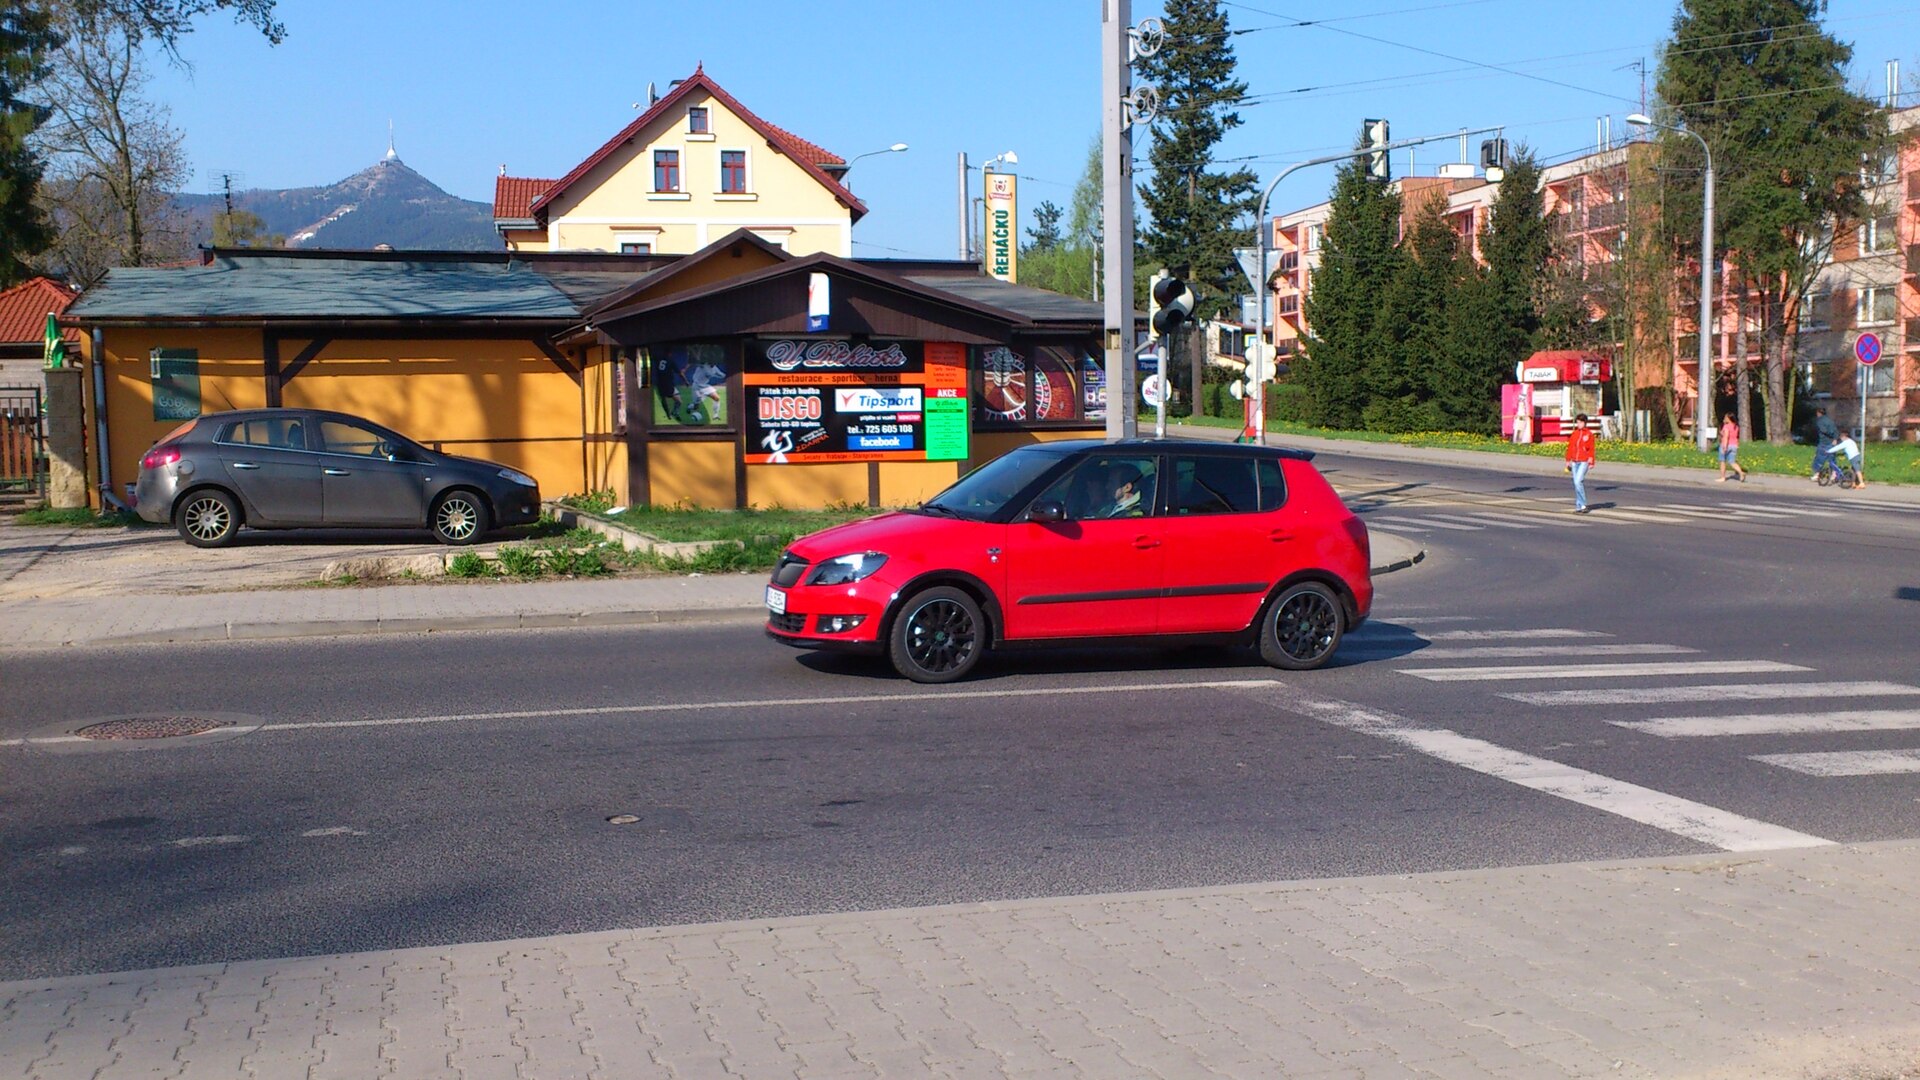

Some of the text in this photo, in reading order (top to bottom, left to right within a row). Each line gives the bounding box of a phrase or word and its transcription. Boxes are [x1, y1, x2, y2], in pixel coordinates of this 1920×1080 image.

[992, 209, 1009, 275] ŘEHÁČKŮ
[778, 375, 823, 383] restaurace
[832, 375, 866, 384] sportbar
[874, 374, 898, 382] herna
[936, 388, 958, 398] AKCE
[859, 395, 914, 408] Tipsport
[759, 396, 822, 420] DISCO
[865, 425, 880, 433] 725
[881, 424, 898, 433] 605
[899, 424, 913, 433] 108
[860, 436, 900, 447] facebook
